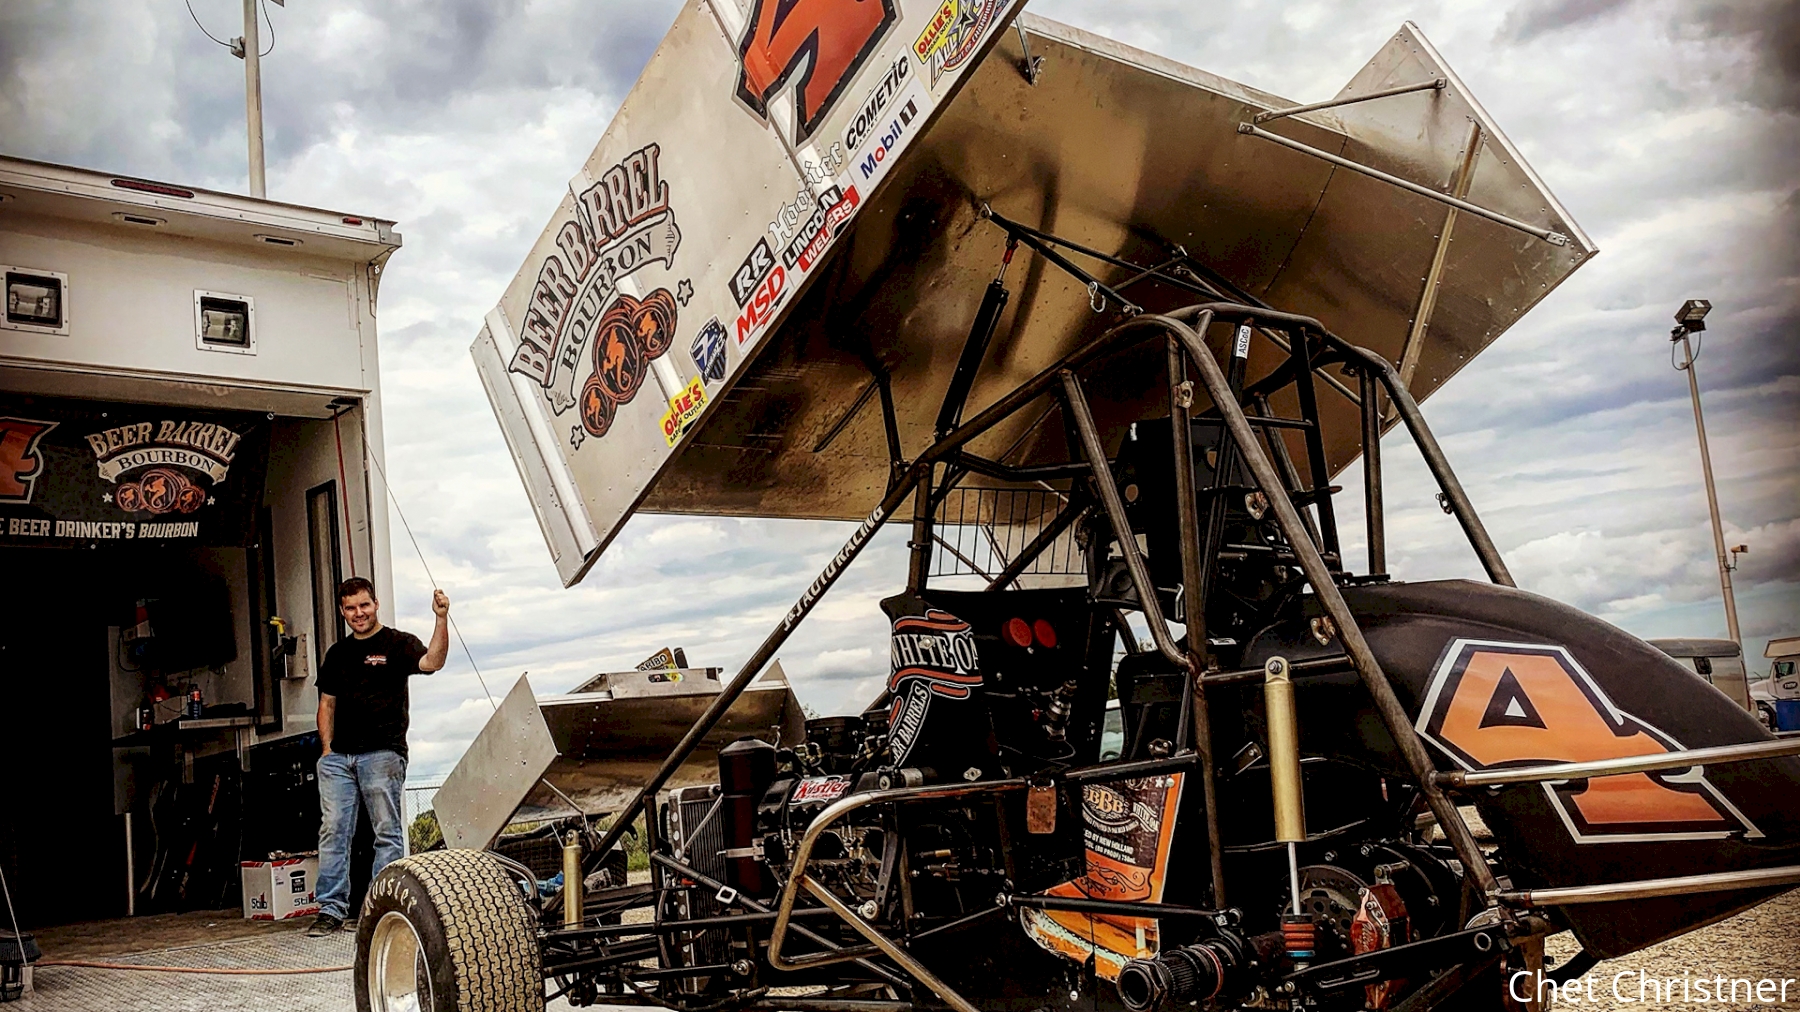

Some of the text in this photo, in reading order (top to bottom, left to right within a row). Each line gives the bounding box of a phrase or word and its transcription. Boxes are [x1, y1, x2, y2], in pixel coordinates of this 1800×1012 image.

[939, 14, 954, 35] OUTLET
[846, 55, 908, 150] COMETIC
[860, 119, 903, 180] Mobil
[783, 188, 840, 267] LINCOLN
[803, 198, 853, 265] WELDERS
[508, 141, 670, 388] BEER BARREL
[560, 231, 653, 373] BOURBON
[735, 264, 785, 346] MSD
[683, 398, 705, 420] OUTLET
[84, 420, 242, 463] BEER BARREL
[117, 450, 216, 473] BOURBON
[9, 518, 50, 536] BEER
[55, 520, 135, 539] DRINKER'S
[138, 521, 199, 539] BOURBON
[897, 685, 929, 746] BARRELS
[790, 780, 852, 801] Kistler
[1087, 788, 1124, 814] BBB
